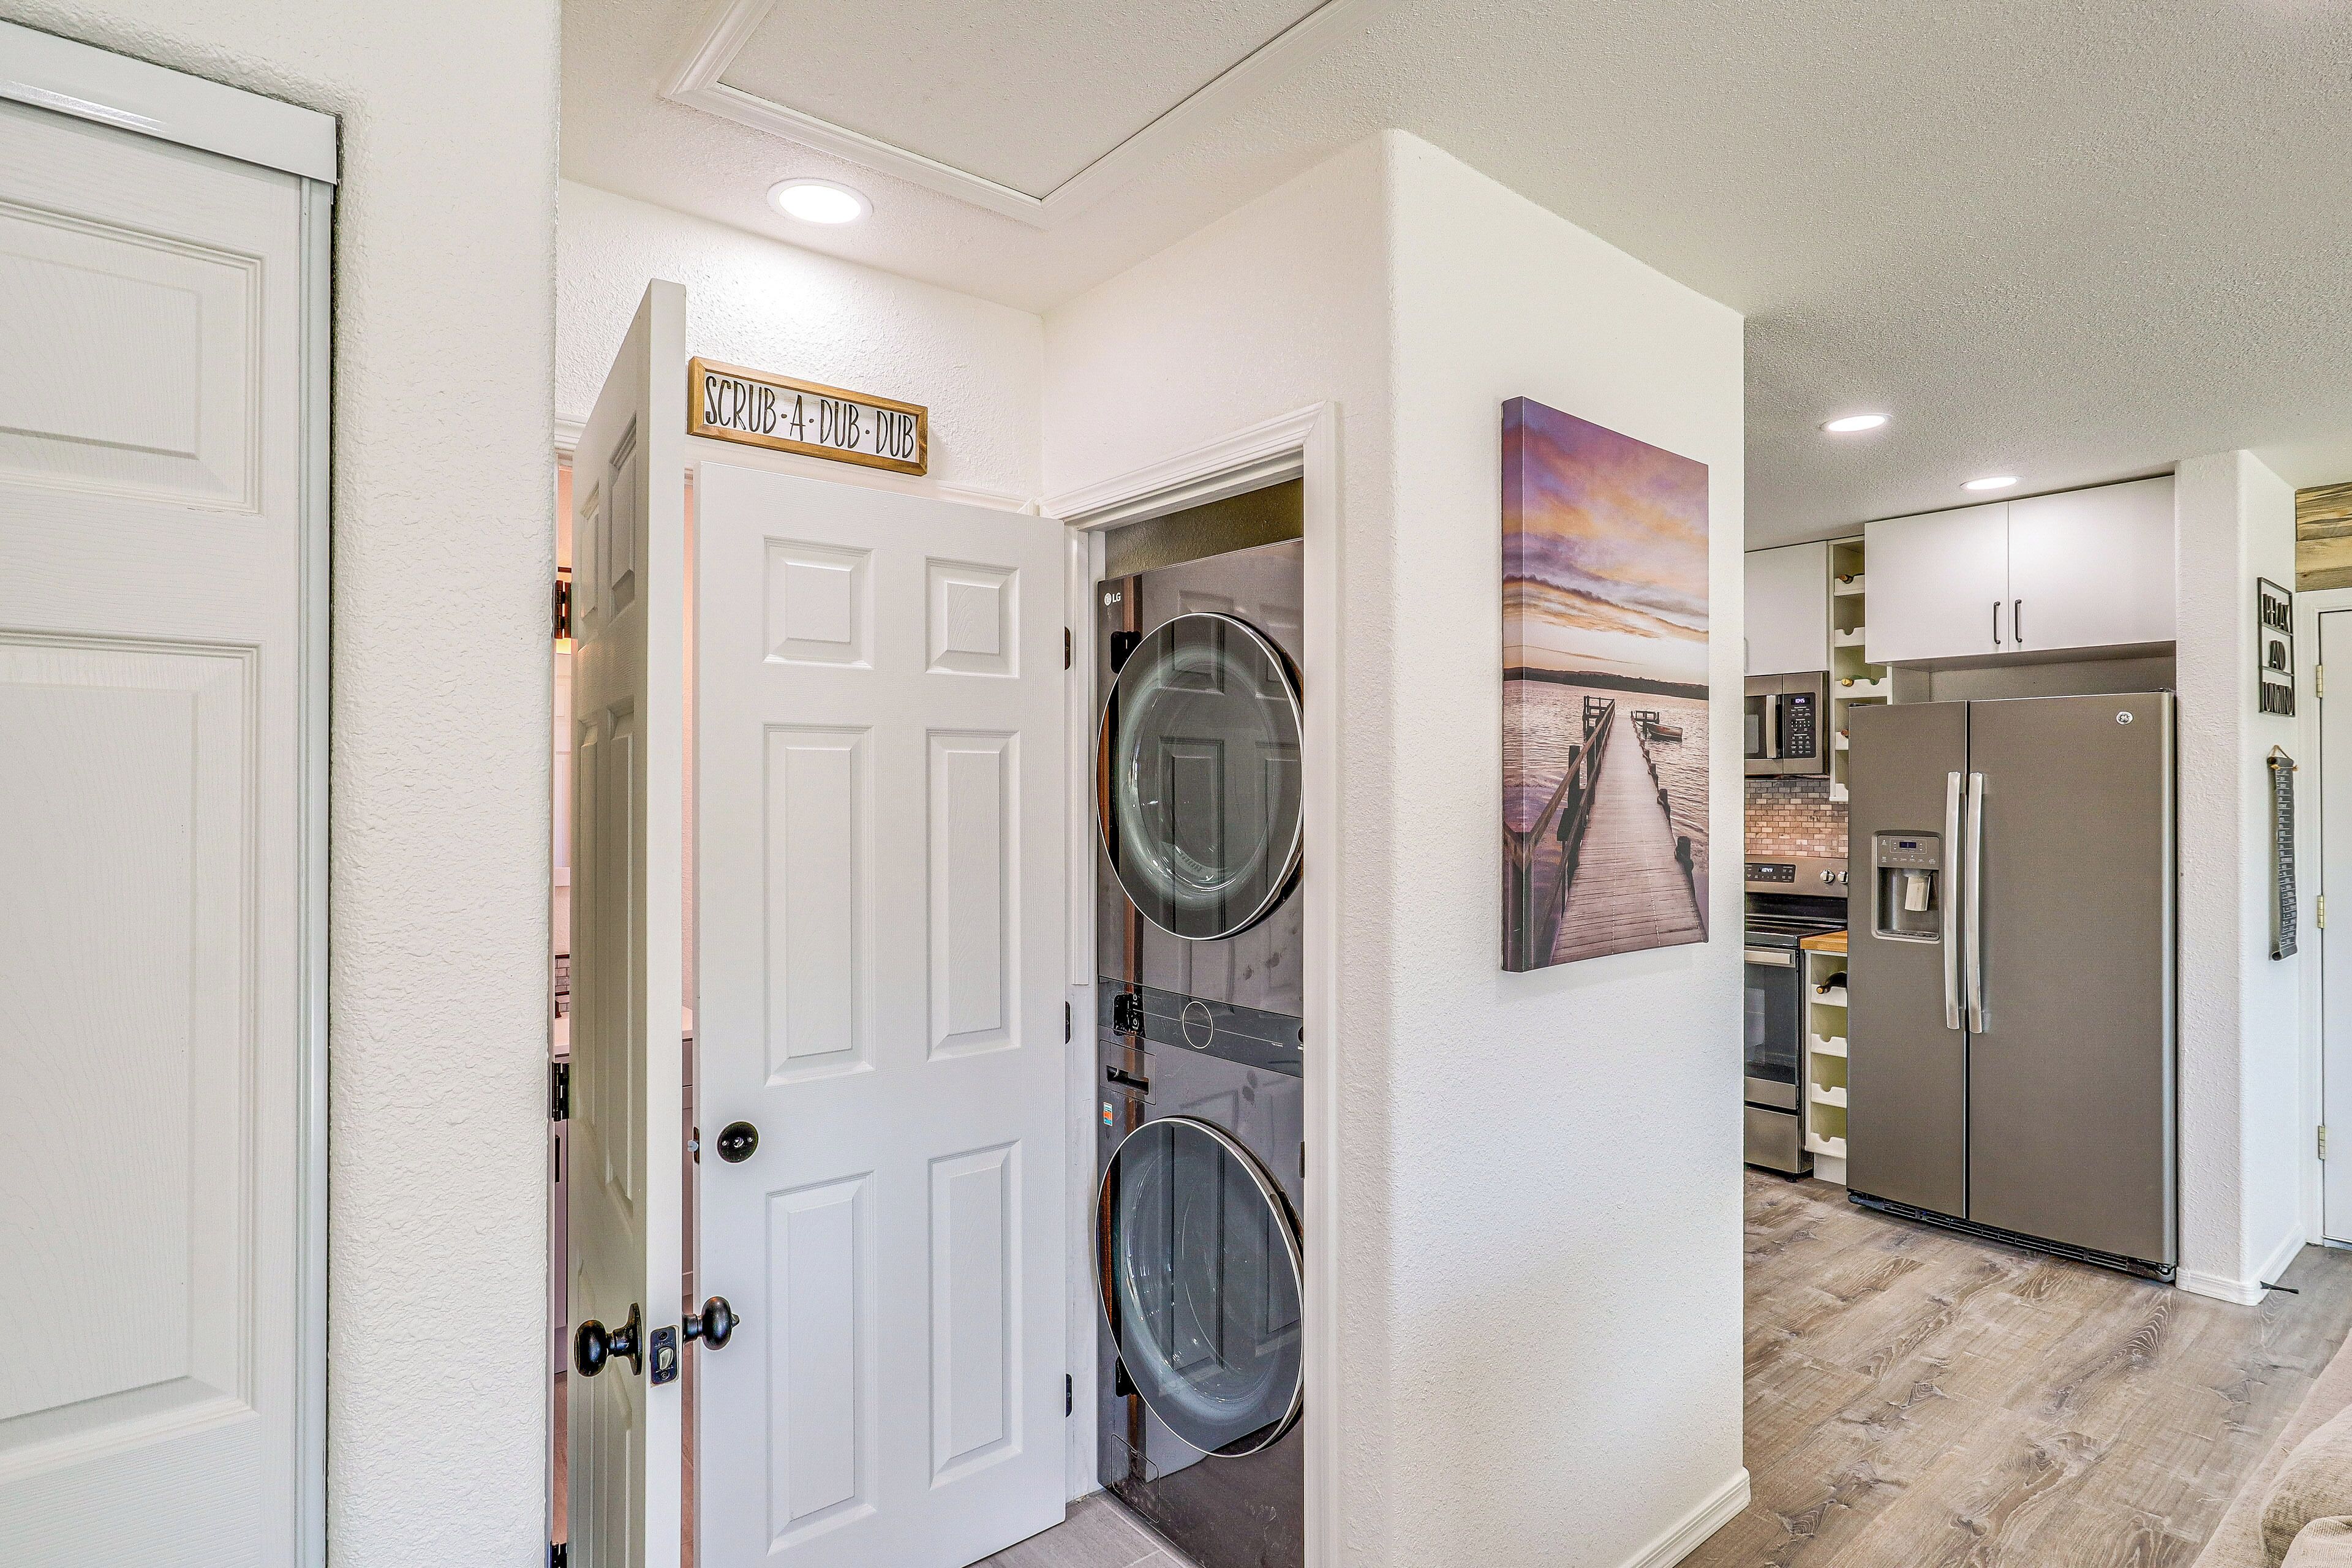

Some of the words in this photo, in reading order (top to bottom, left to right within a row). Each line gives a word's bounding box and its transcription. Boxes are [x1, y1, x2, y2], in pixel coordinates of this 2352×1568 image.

[705, 375, 777, 434] SCRUB
[820, 399, 860, 449] DUB
[876, 410, 914, 459] DUB
[1112, 592, 1121, 603] LG
